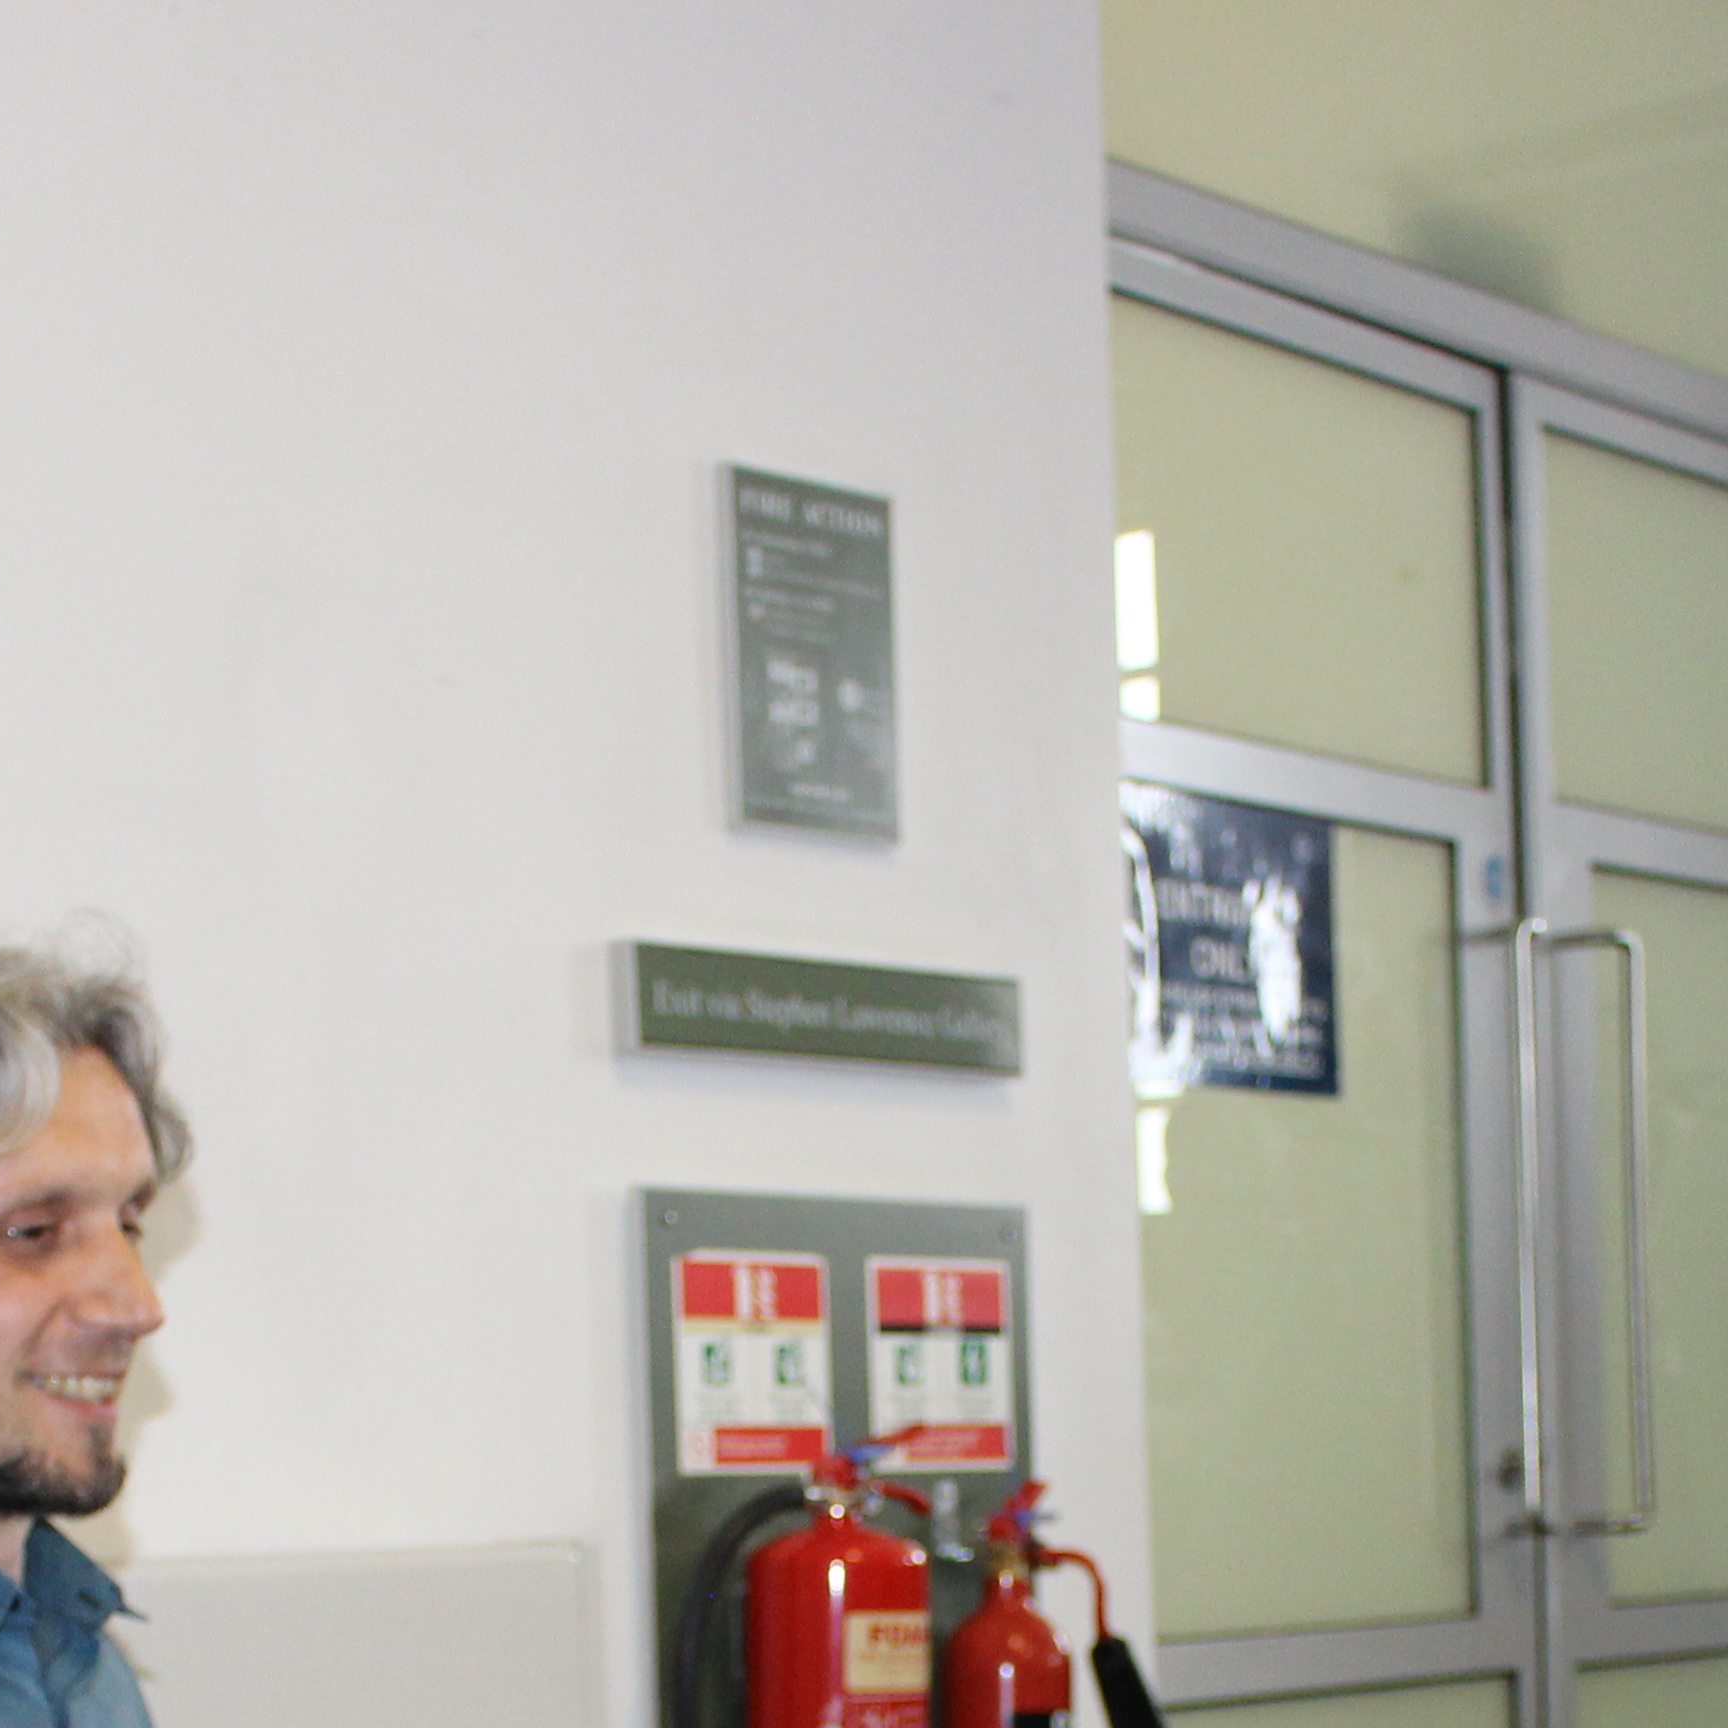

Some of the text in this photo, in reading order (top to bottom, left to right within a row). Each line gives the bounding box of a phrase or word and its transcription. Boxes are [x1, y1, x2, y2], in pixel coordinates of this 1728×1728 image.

[653, 979, 702, 1018] Exit
[745, 987, 830, 1033] Stephen
[835, 995, 936, 1038] Lawrence
